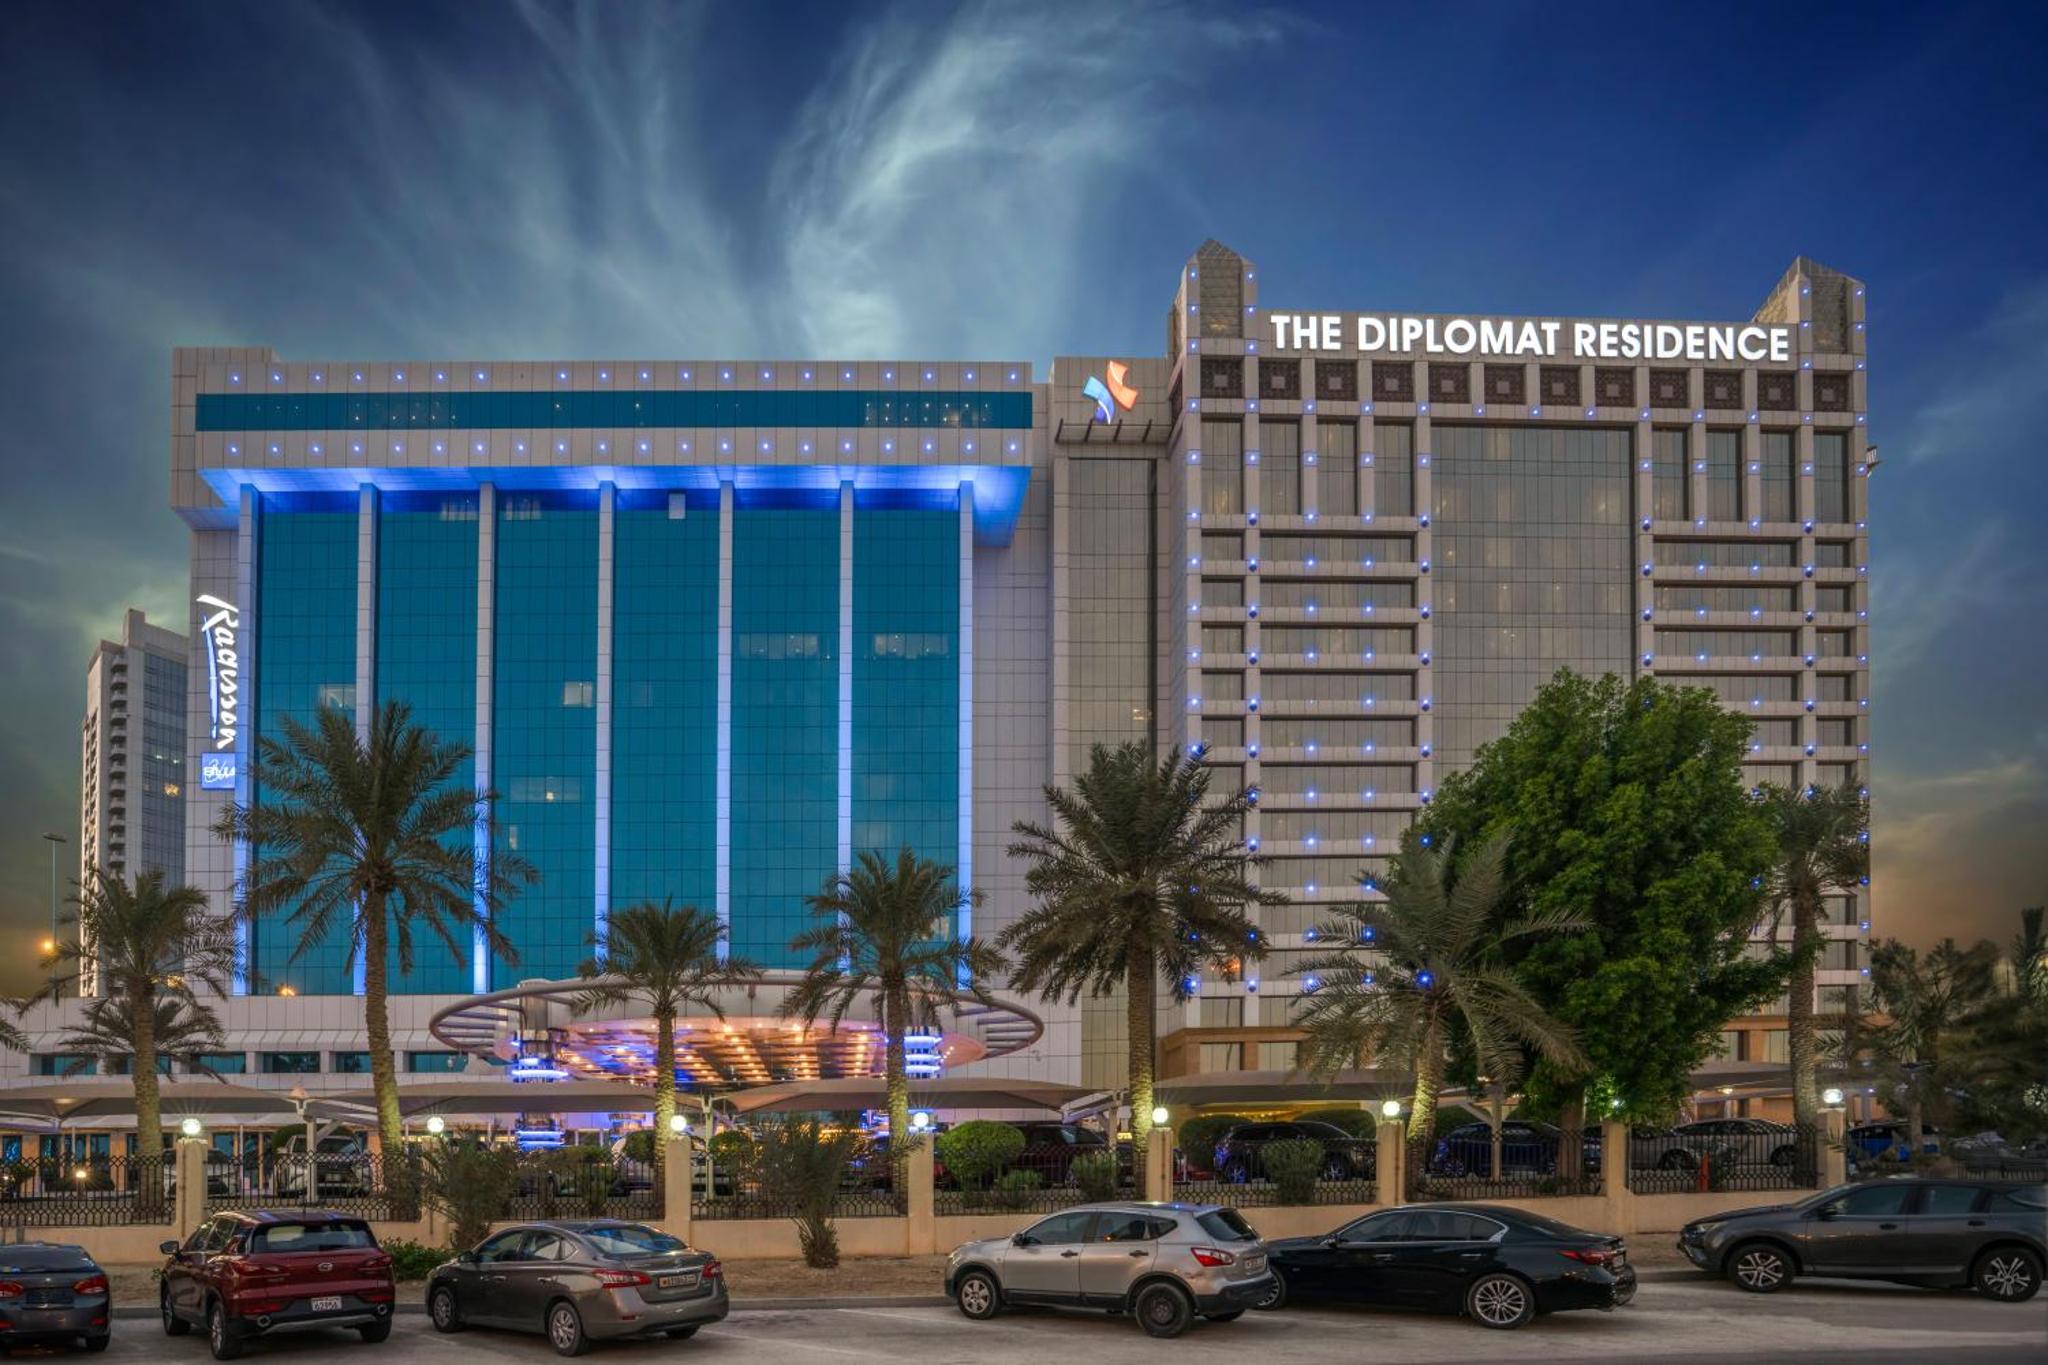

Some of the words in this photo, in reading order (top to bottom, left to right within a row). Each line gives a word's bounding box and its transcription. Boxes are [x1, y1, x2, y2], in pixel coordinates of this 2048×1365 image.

[1270, 315, 1342, 351] THE
[1358, 317, 1561, 356] DIPLOMAT
[1574, 323, 1789, 361] RESIDENCE
[196, 594, 239, 750] Radisson
